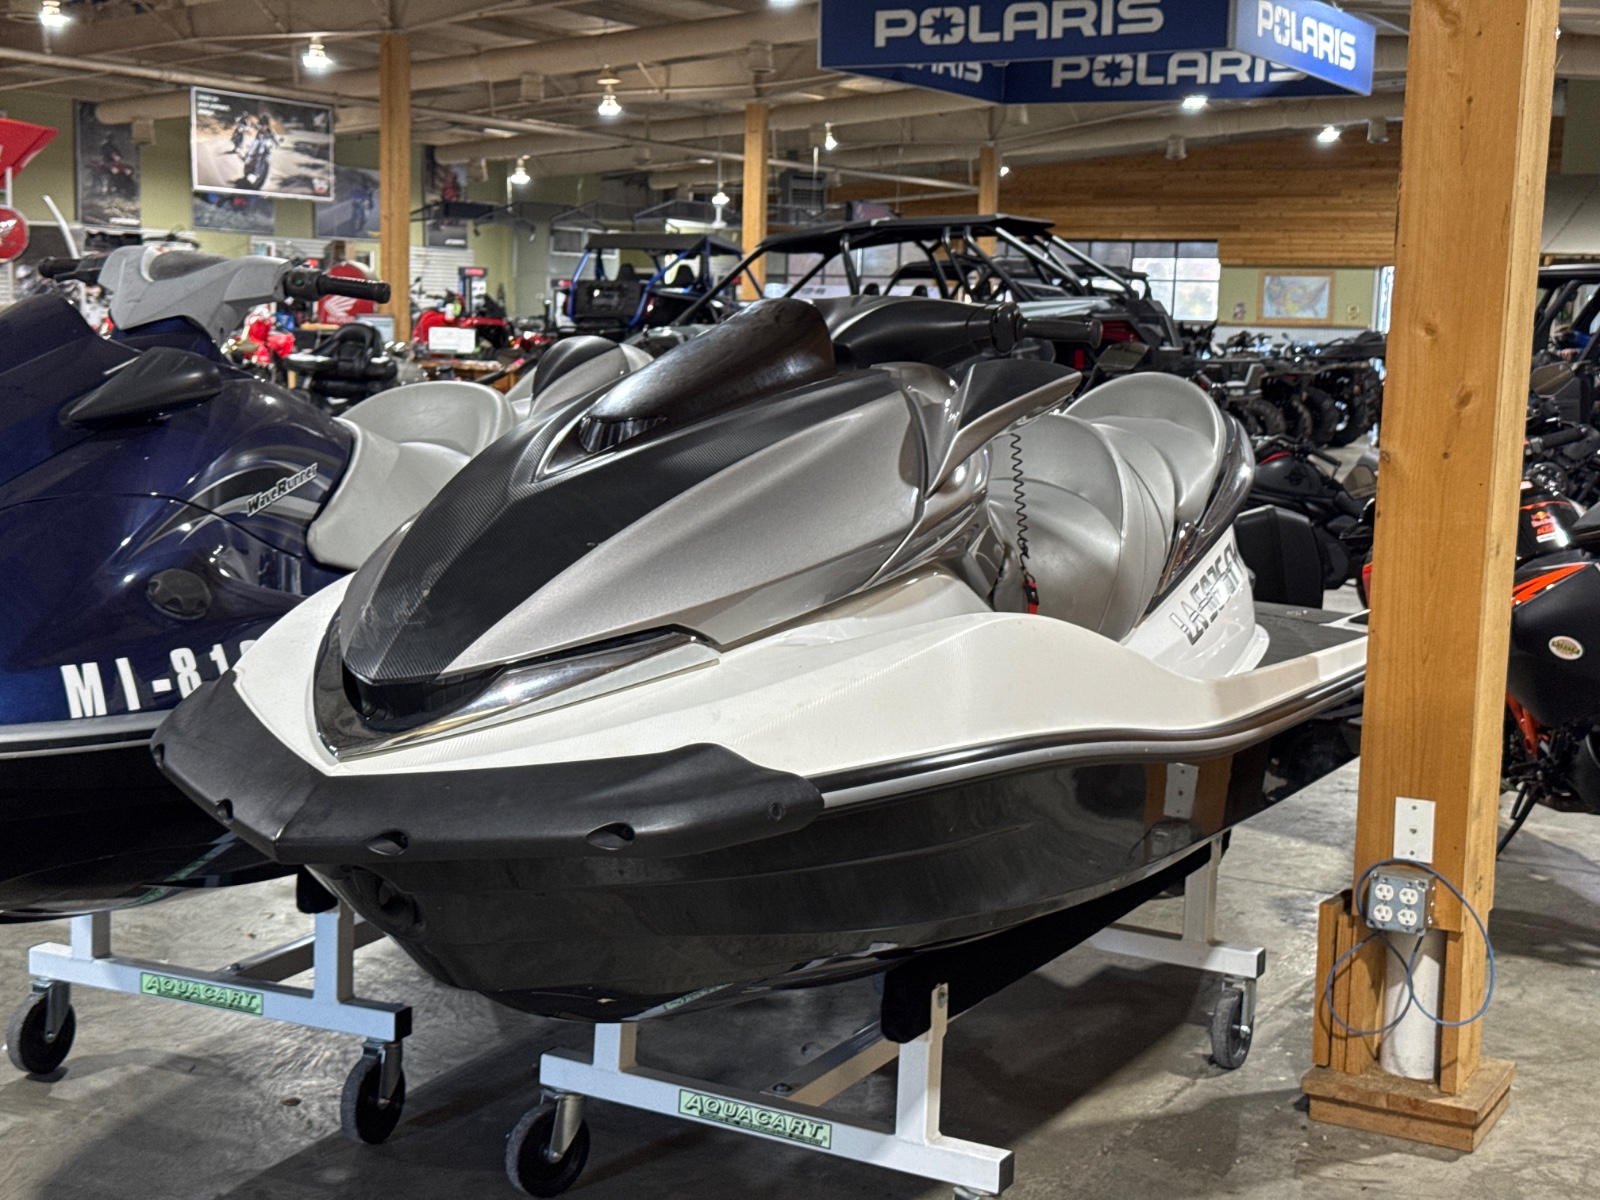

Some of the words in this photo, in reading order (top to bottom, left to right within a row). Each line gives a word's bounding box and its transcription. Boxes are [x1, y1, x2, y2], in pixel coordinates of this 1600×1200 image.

[874, 0, 1165, 48] POLARIS
[1256, 0, 1357, 71] POLARIS
[60, 639, 257, 719] MI-81
[145, 975, 259, 1009] AQUACART
[684, 1093, 824, 1138] AQUACART
